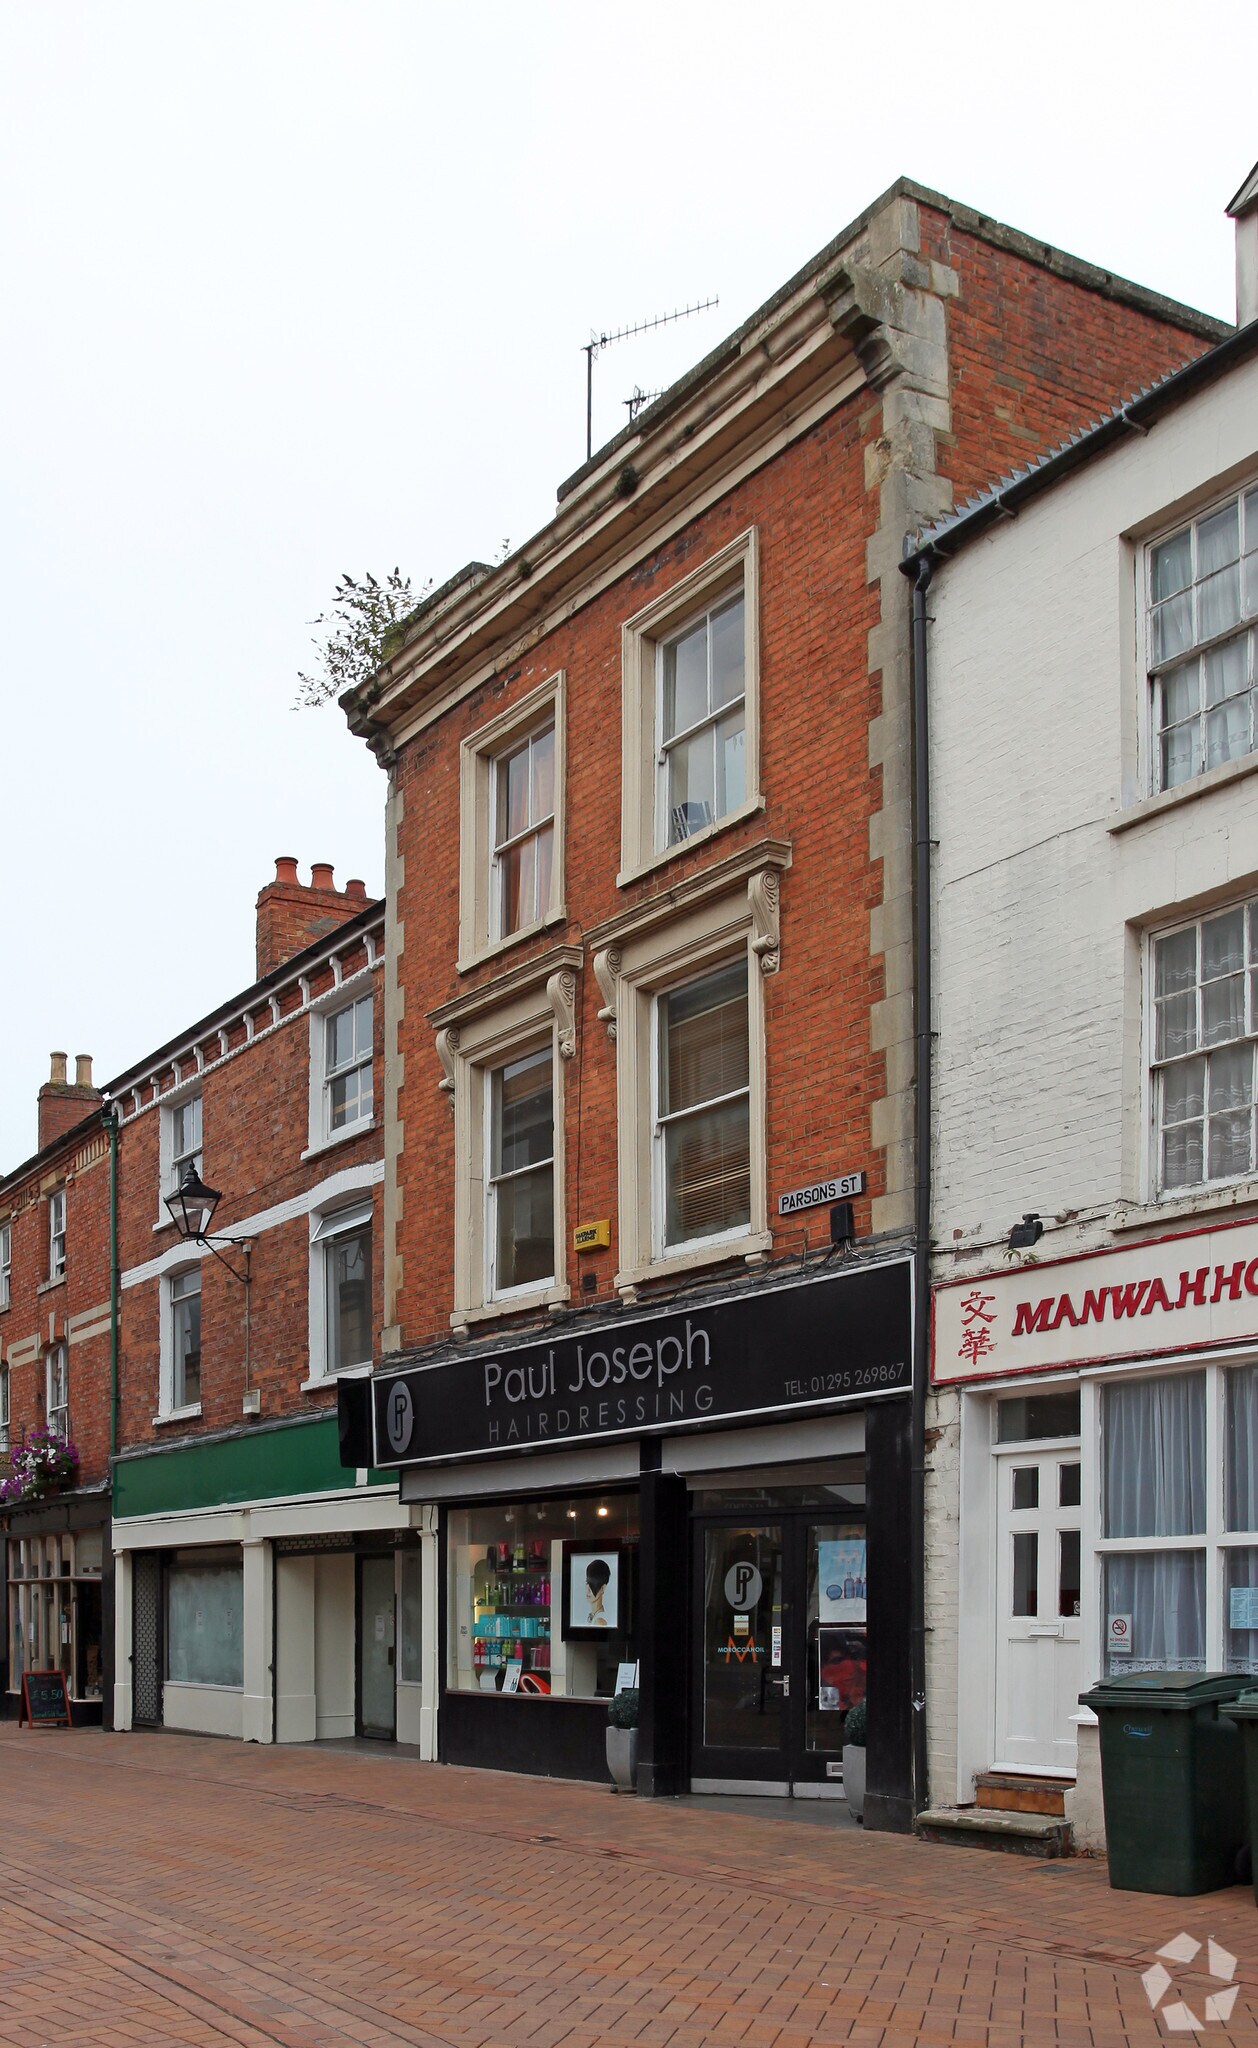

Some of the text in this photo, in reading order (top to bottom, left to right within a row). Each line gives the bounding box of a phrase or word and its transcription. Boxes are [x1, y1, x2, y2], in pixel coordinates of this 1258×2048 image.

[781, 1176, 857, 1212] PARSONS ST
[484, 1320, 711, 1406] Paul Joseph
[784, 1362, 905, 1396] TEL: 01295 269867
[489, 1385, 714, 1443] HAIRDRESSING
